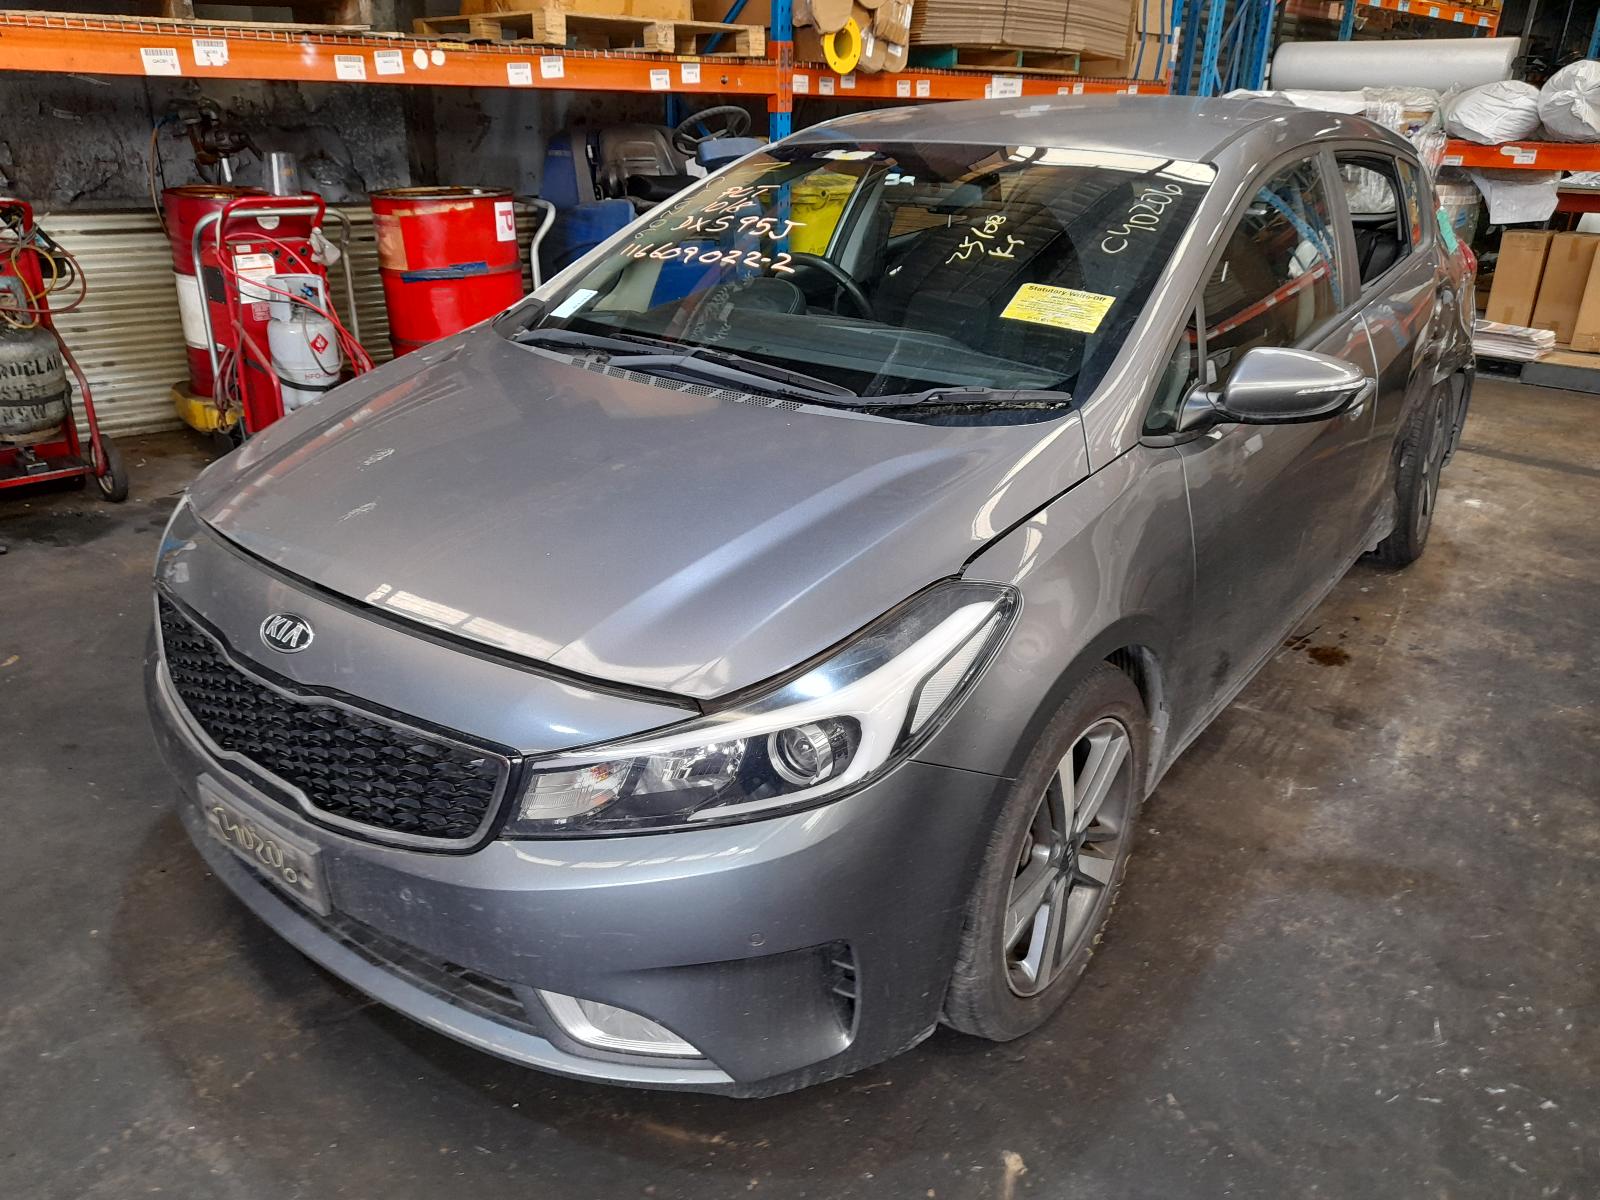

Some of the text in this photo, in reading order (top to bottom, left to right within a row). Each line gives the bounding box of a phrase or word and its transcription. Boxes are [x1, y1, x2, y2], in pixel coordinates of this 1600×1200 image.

[1027, 285, 1107, 303] Statutory Write-Off
[265, 615, 306, 648] KIA
